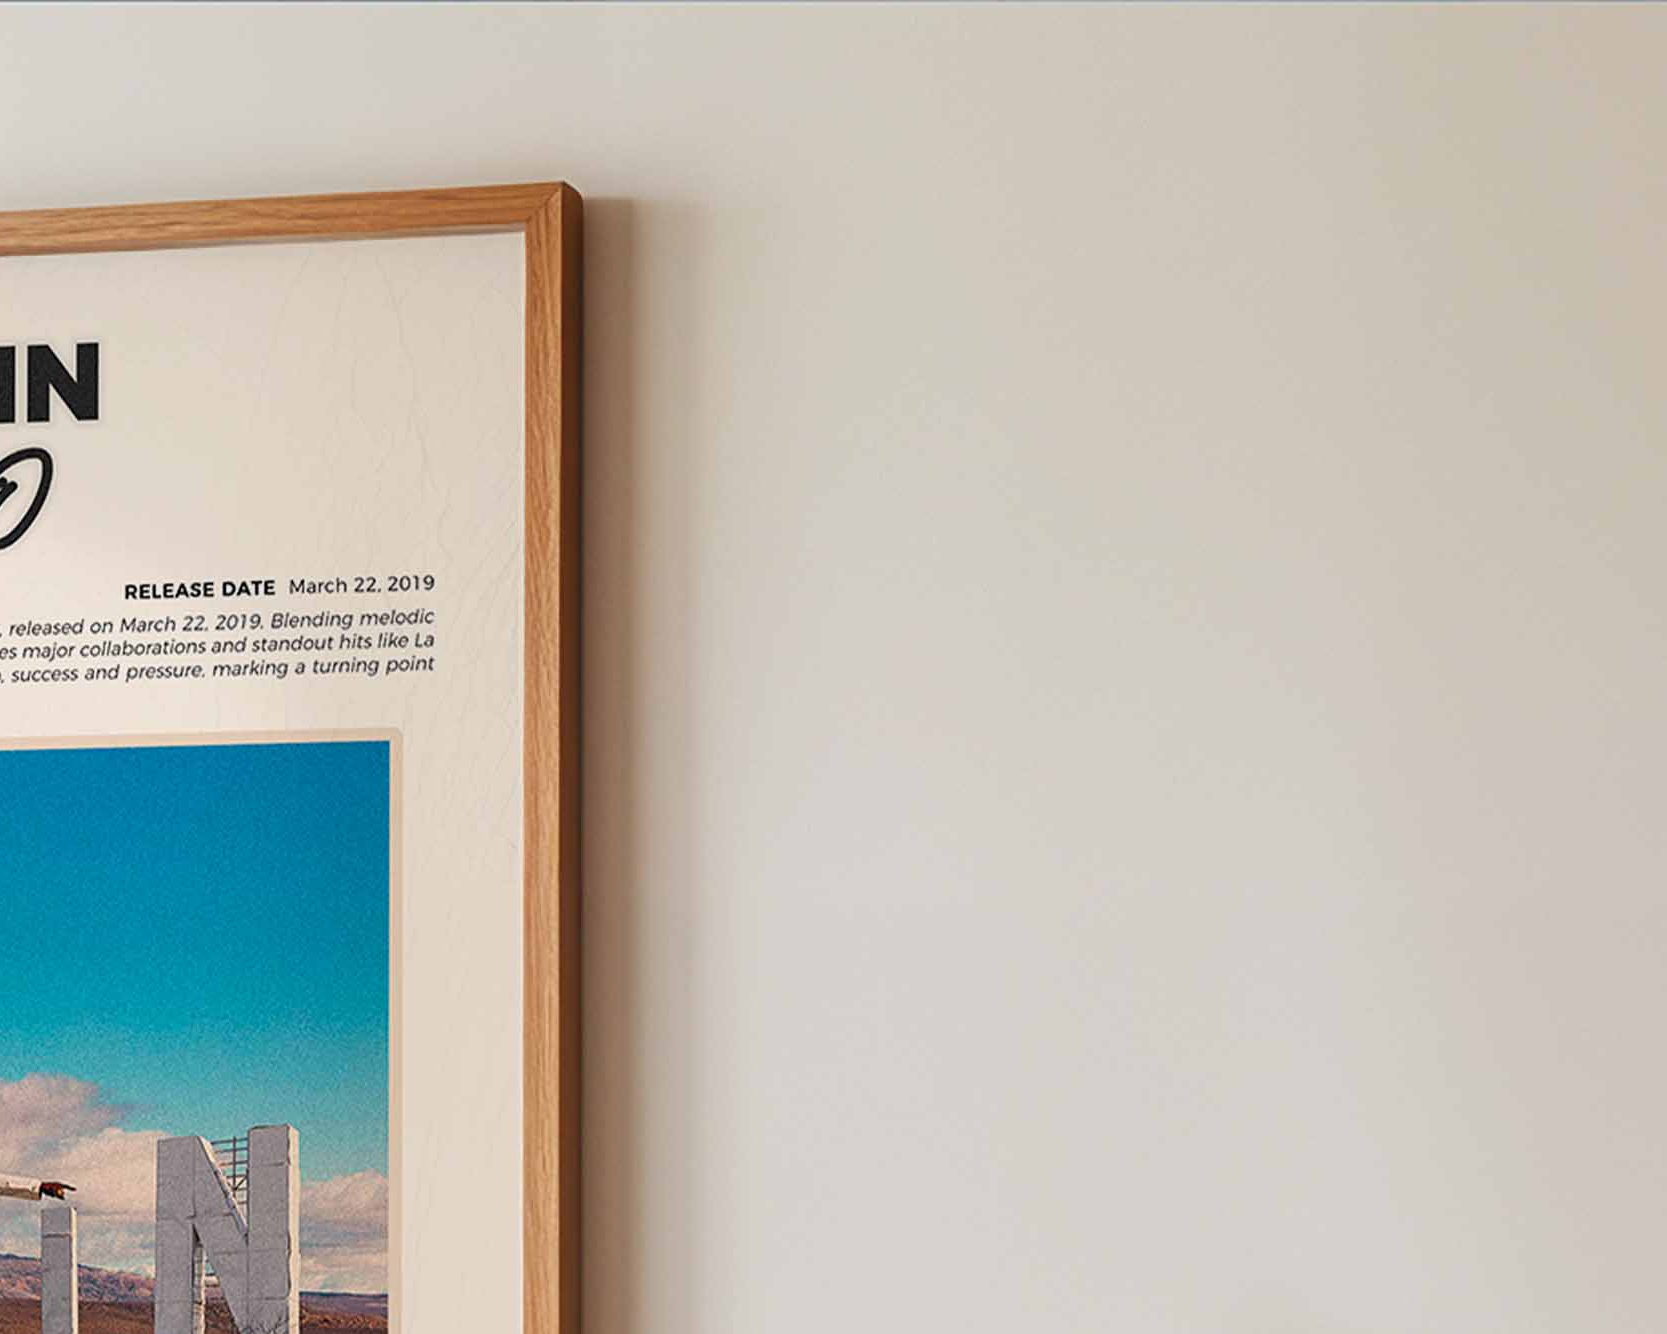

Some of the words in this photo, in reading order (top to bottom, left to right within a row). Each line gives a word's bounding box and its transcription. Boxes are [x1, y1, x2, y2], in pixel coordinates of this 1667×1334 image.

[125, 582, 215, 601] RELEASE
[222, 579, 276, 597] DATE
[289, 577, 347, 595] March
[387, 574, 435, 592] 2019
[8, 618, 85, 637] released
[89, 620, 114, 635] on
[119, 616, 177, 634] March
[270, 610, 354, 631] Blending
[358, 607, 435, 629] melodic
[22, 642, 76, 662] major
[79, 639, 207, 658] collaborations
[211, 637, 248, 655] and
[251, 635, 334, 654] standout
[338, 634, 372, 650] hits
[377, 633, 410, 649] like
[414, 632, 435, 648] La
[11, 668, 79, 683] success
[84, 663, 121, 681] and
[212, 659, 289, 679] marking
[294, 661, 307, 676] a
[312, 657, 380, 677] turning
[385, 655, 435, 676] point
